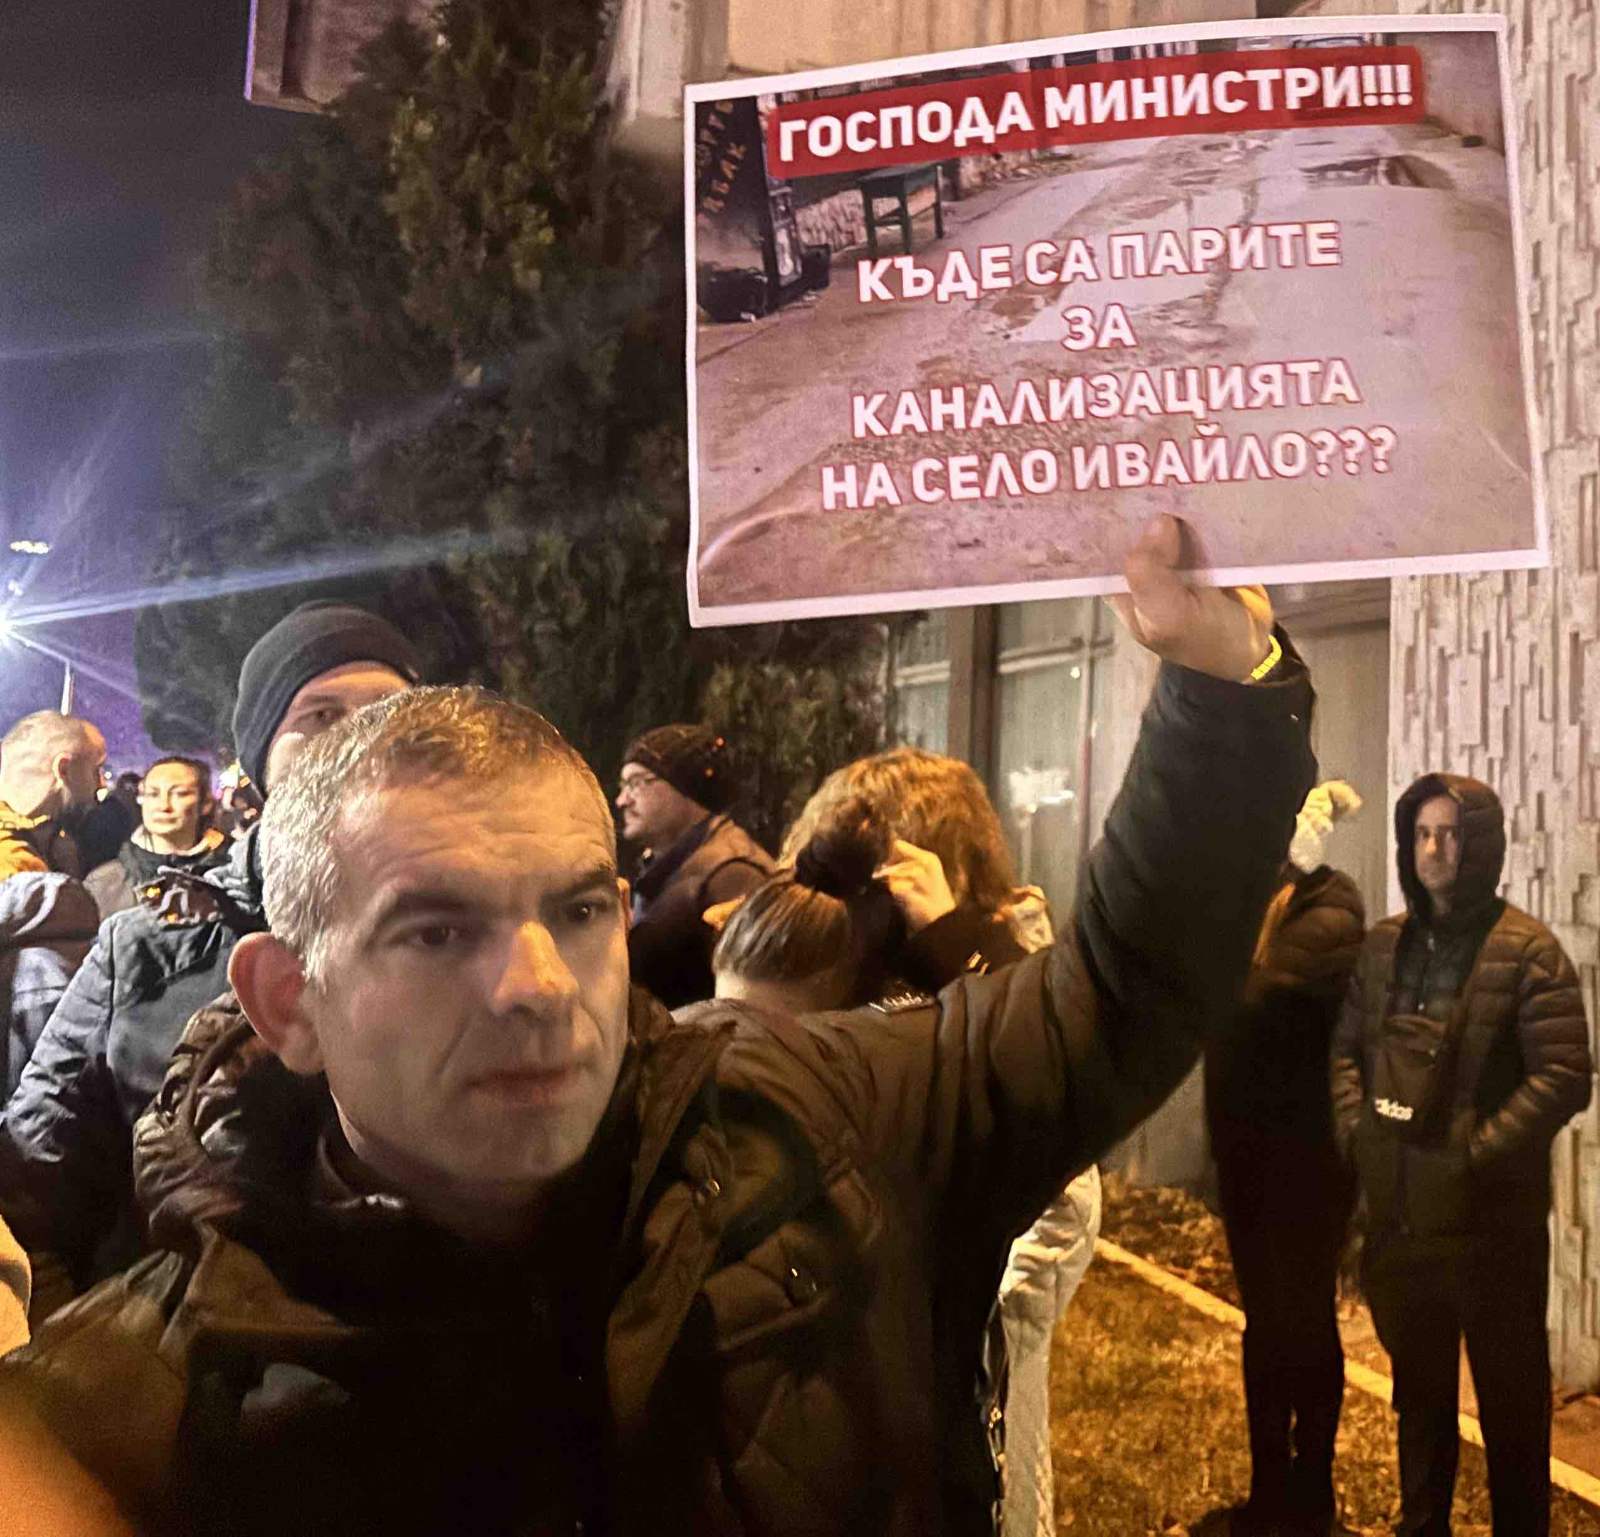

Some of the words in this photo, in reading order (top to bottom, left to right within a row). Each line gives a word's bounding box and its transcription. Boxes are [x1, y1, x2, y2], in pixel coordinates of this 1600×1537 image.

[779, 92, 1034, 162] ГОСПОДА
[1044, 64, 1413, 129] МИНИСТРИ!!!
[857, 244, 1013, 303] КЪДЕ
[1024, 238, 1099, 285] СА
[1108, 220, 1342, 279] ПАРИТЕ
[1061, 303, 1138, 351] ЗА
[852, 358, 1362, 438] КАНАЛИЗАЦИЯТА
[821, 461, 902, 511] НА
[911, 448, 1059, 504] СЕЛО
[1072, 424, 1398, 492] ИВАЙЛО???
